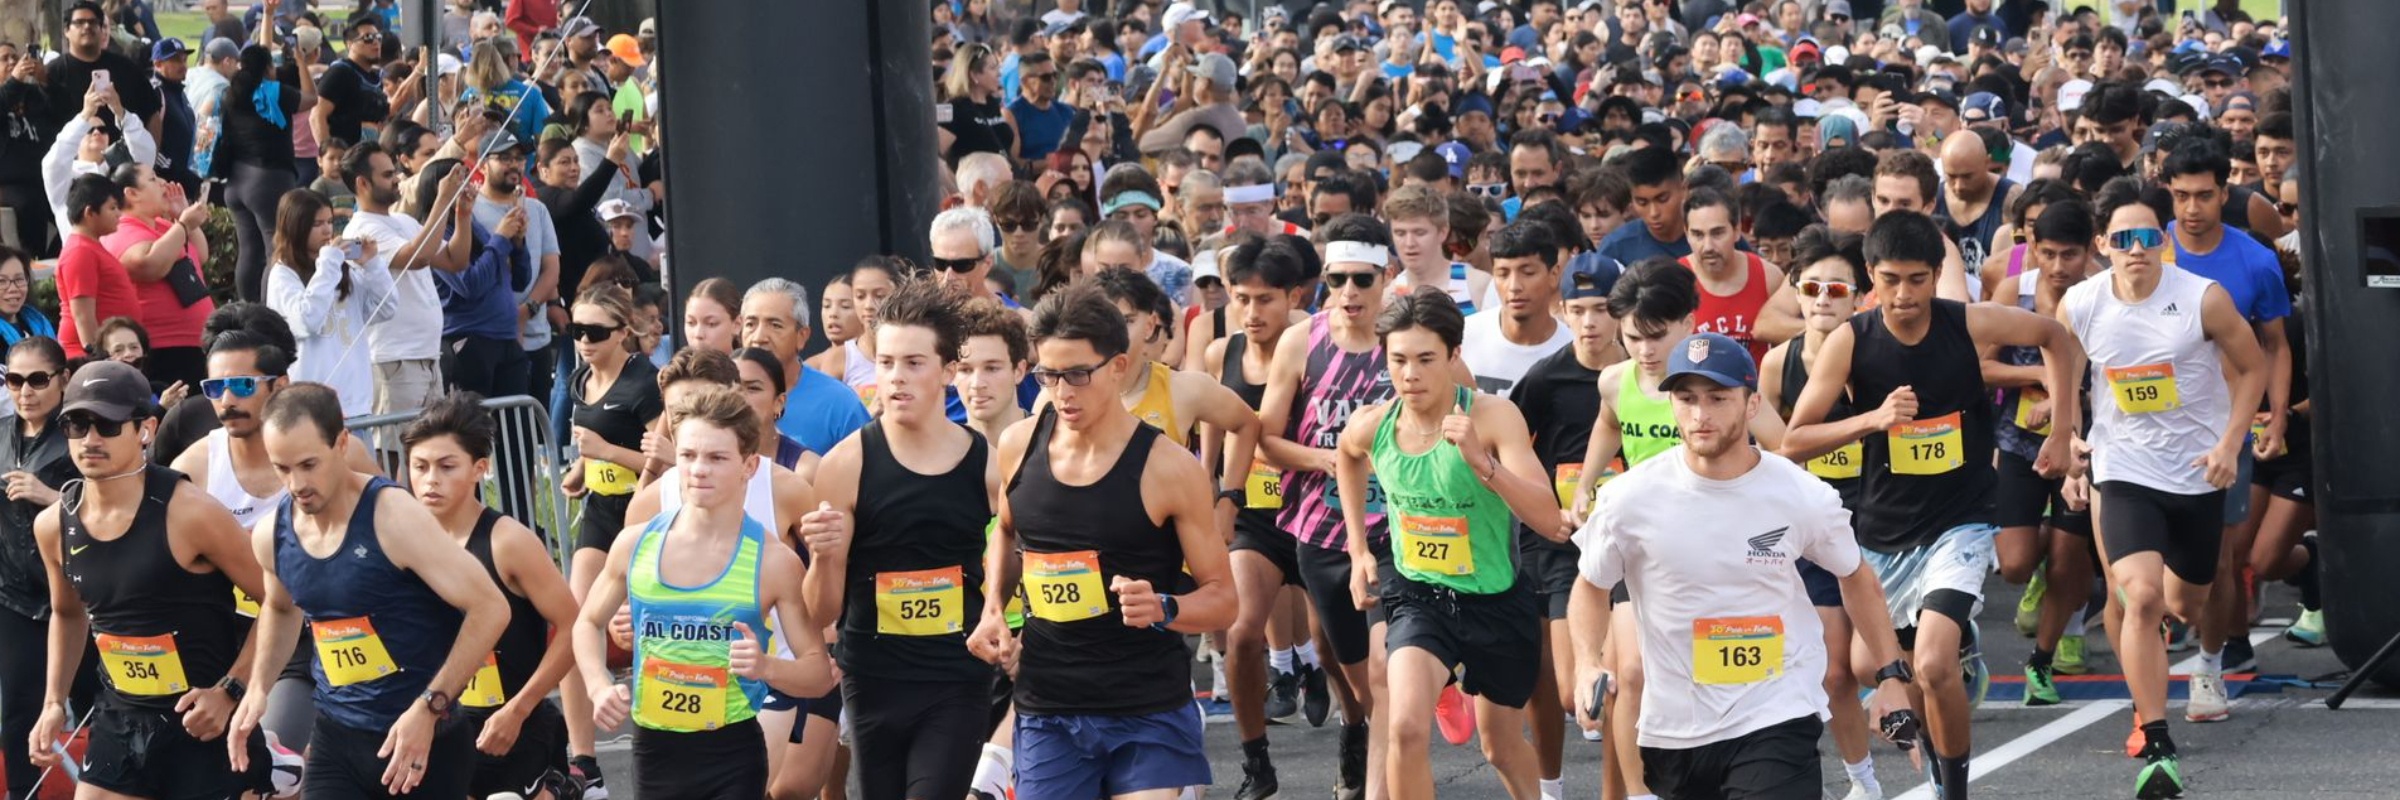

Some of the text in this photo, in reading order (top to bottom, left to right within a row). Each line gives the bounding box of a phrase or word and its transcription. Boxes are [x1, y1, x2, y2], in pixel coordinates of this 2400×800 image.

[2125, 386, 2158, 402] 159
[1910, 442, 1945, 461] 178
[599, 468, 615, 483] 16
[1416, 541, 1449, 560] 227
[1747, 550, 1786, 558] HONDA
[1041, 582, 1080, 604] 528
[901, 598, 941, 620] 525
[641, 621, 733, 640] AL COAST
[331, 646, 367, 669] 716
[1719, 646, 1762, 667] 163
[123, 661, 159, 680] 354
[661, 690, 702, 714] 228
